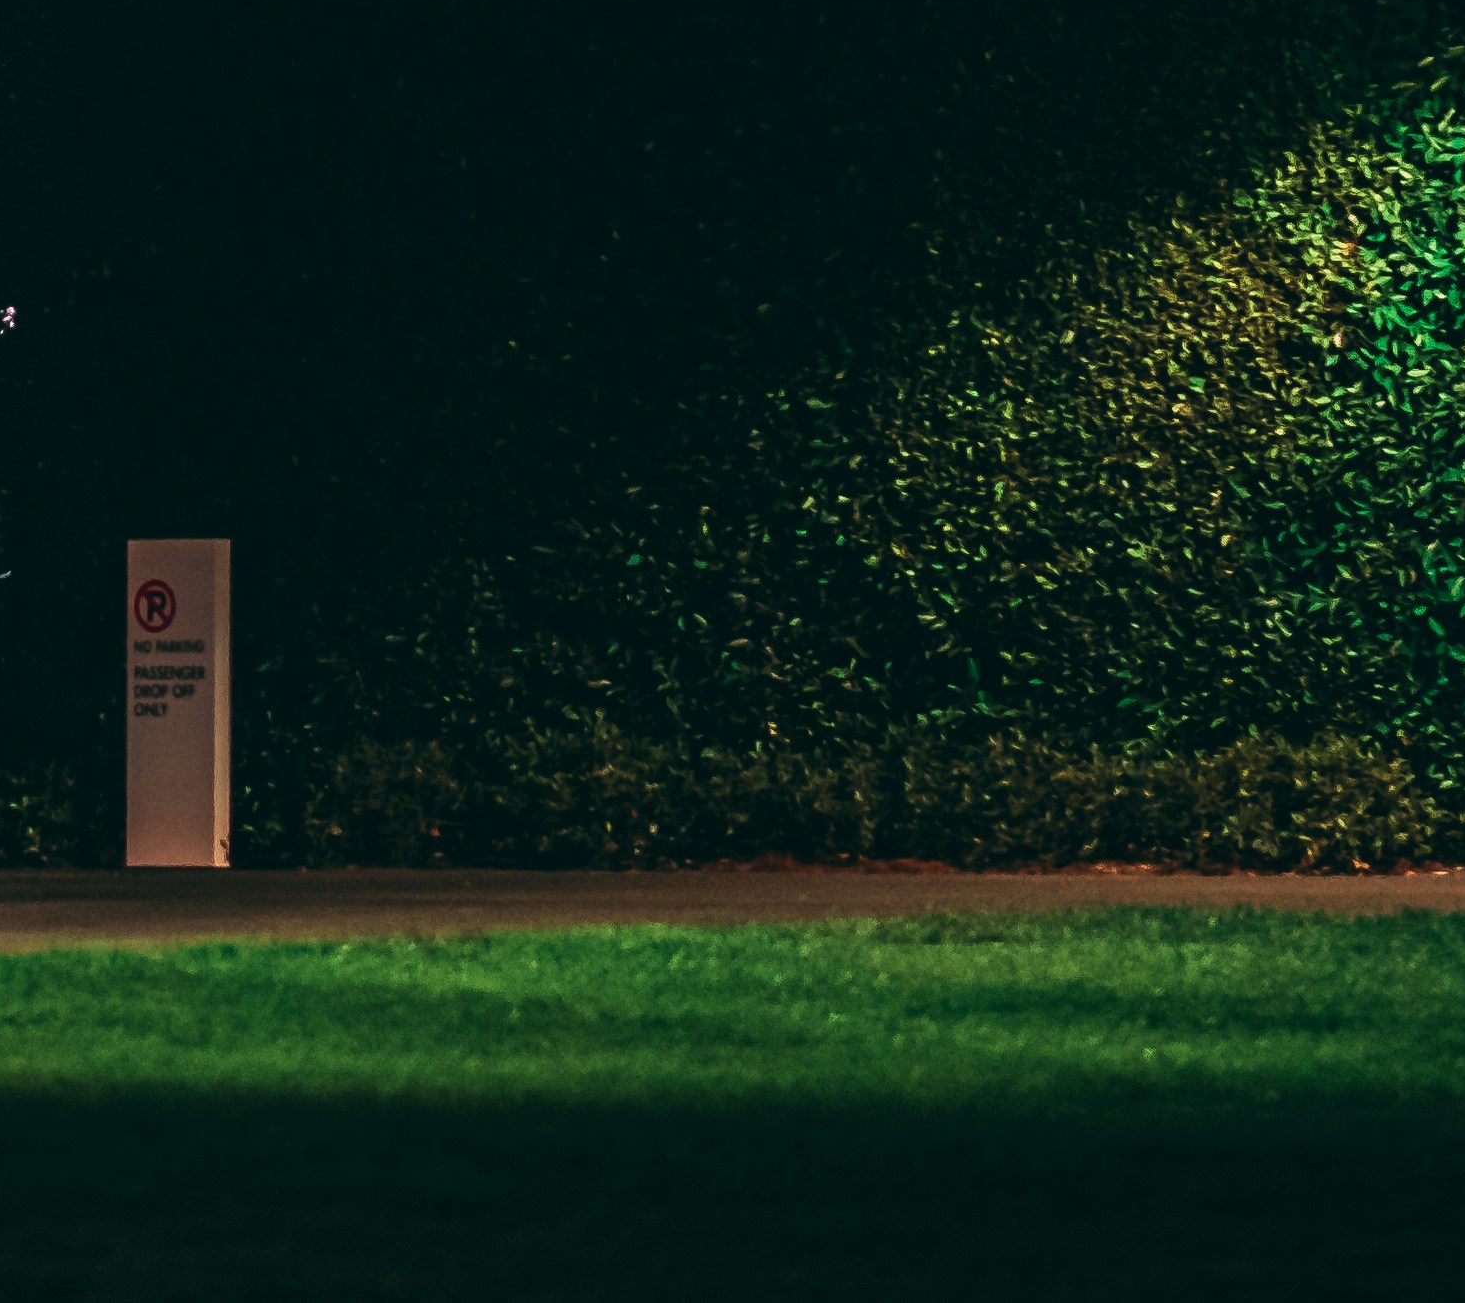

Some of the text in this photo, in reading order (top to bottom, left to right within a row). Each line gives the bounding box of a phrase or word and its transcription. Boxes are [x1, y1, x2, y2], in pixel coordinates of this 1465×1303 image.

[133, 640, 152, 654] NO
[133, 665, 205, 681] PASSENGER
[133, 683, 195, 699] DROP OFF
[133, 702, 168, 717] ONLY
